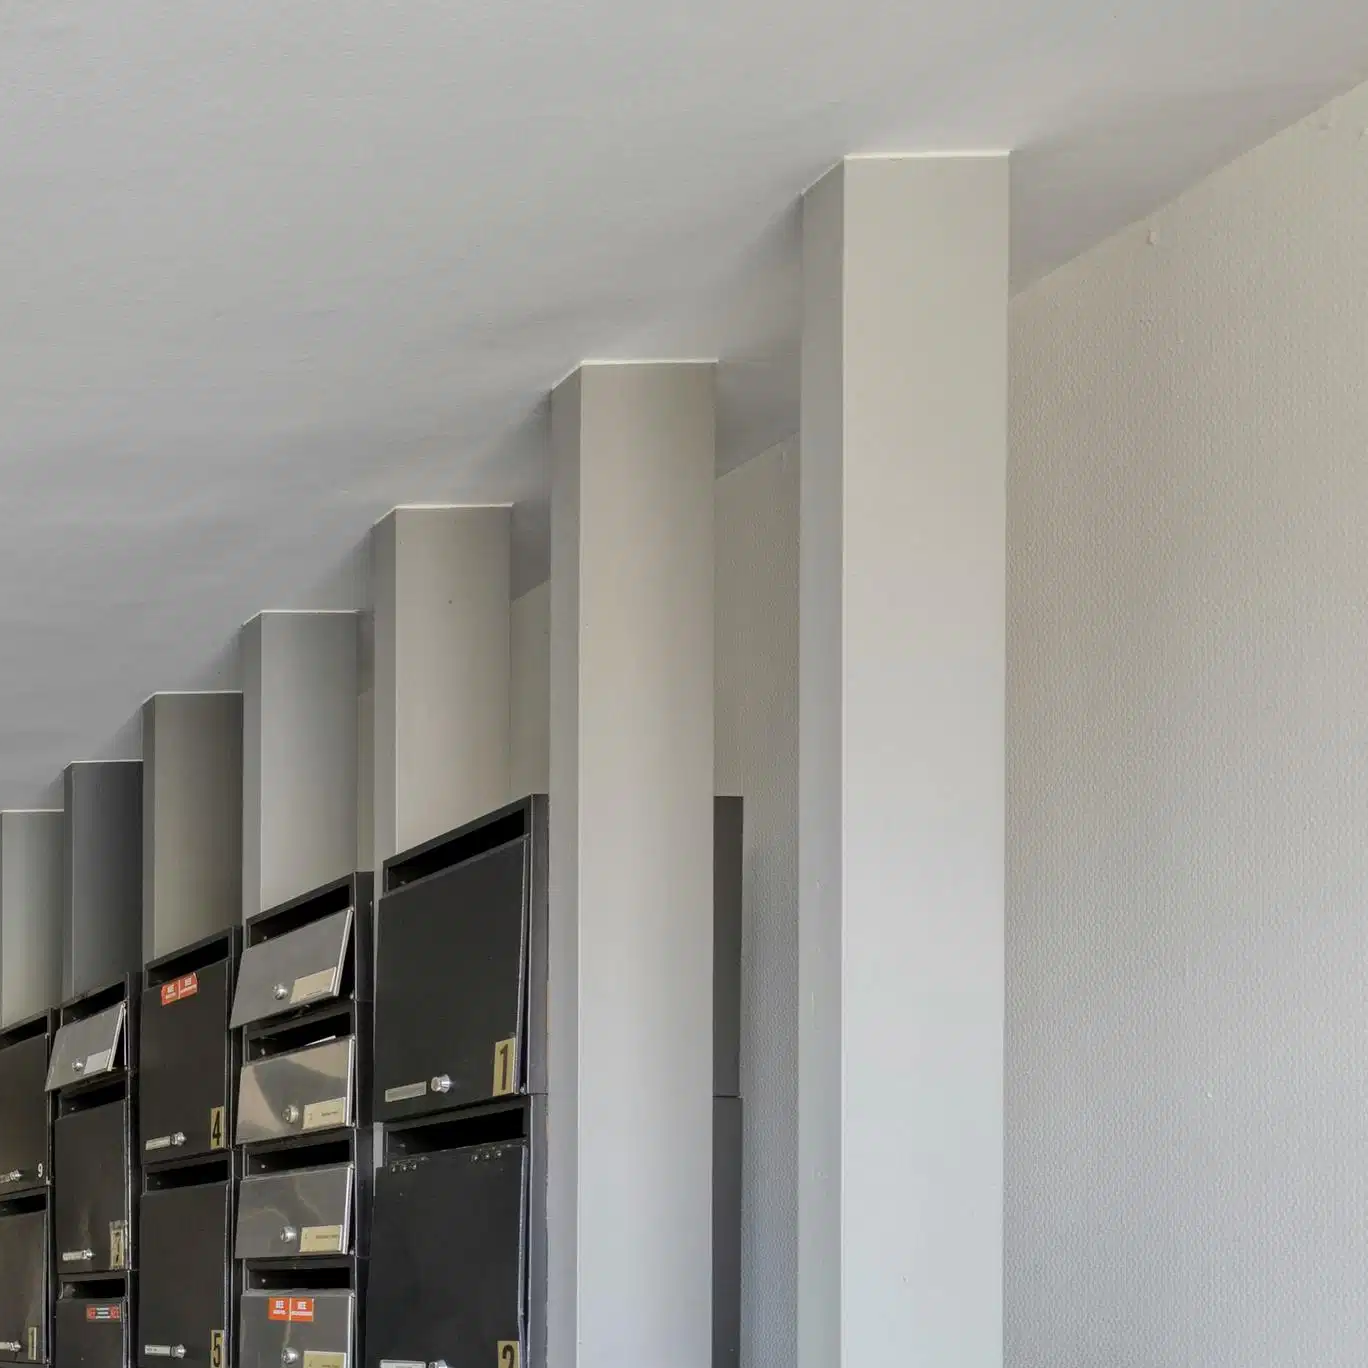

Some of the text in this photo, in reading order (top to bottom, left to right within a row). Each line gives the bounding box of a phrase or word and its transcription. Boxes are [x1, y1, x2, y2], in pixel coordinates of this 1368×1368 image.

[499, 1044, 509, 1091] 1
[212, 1110, 222, 1146] 4
[213, 1332, 221, 1368] 5
